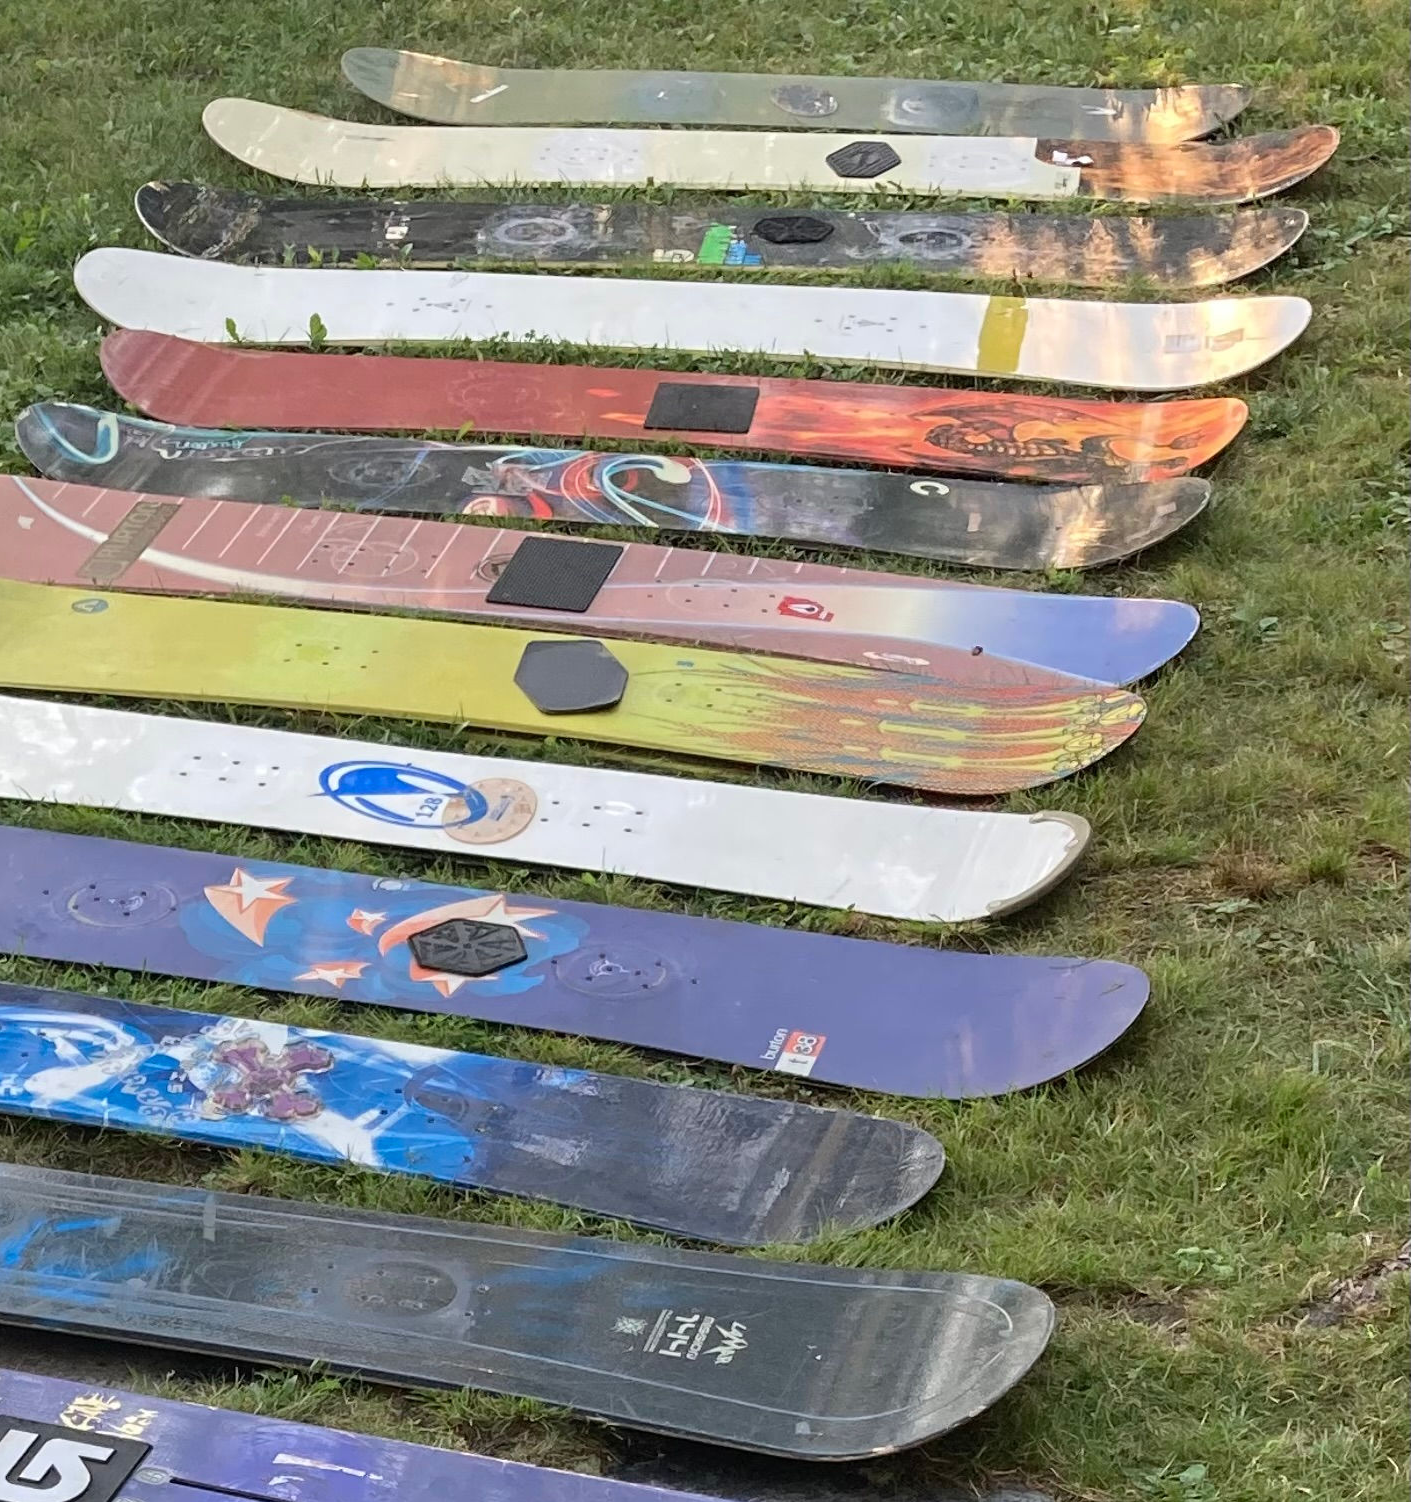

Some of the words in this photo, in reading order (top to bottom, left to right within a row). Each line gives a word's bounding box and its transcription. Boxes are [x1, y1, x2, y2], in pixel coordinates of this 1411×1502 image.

[414, 796, 444, 820] 128
[760, 1028, 788, 1060] burton
[658, 1313, 700, 1358] 144
[702, 1321, 749, 1366] LAMAR
